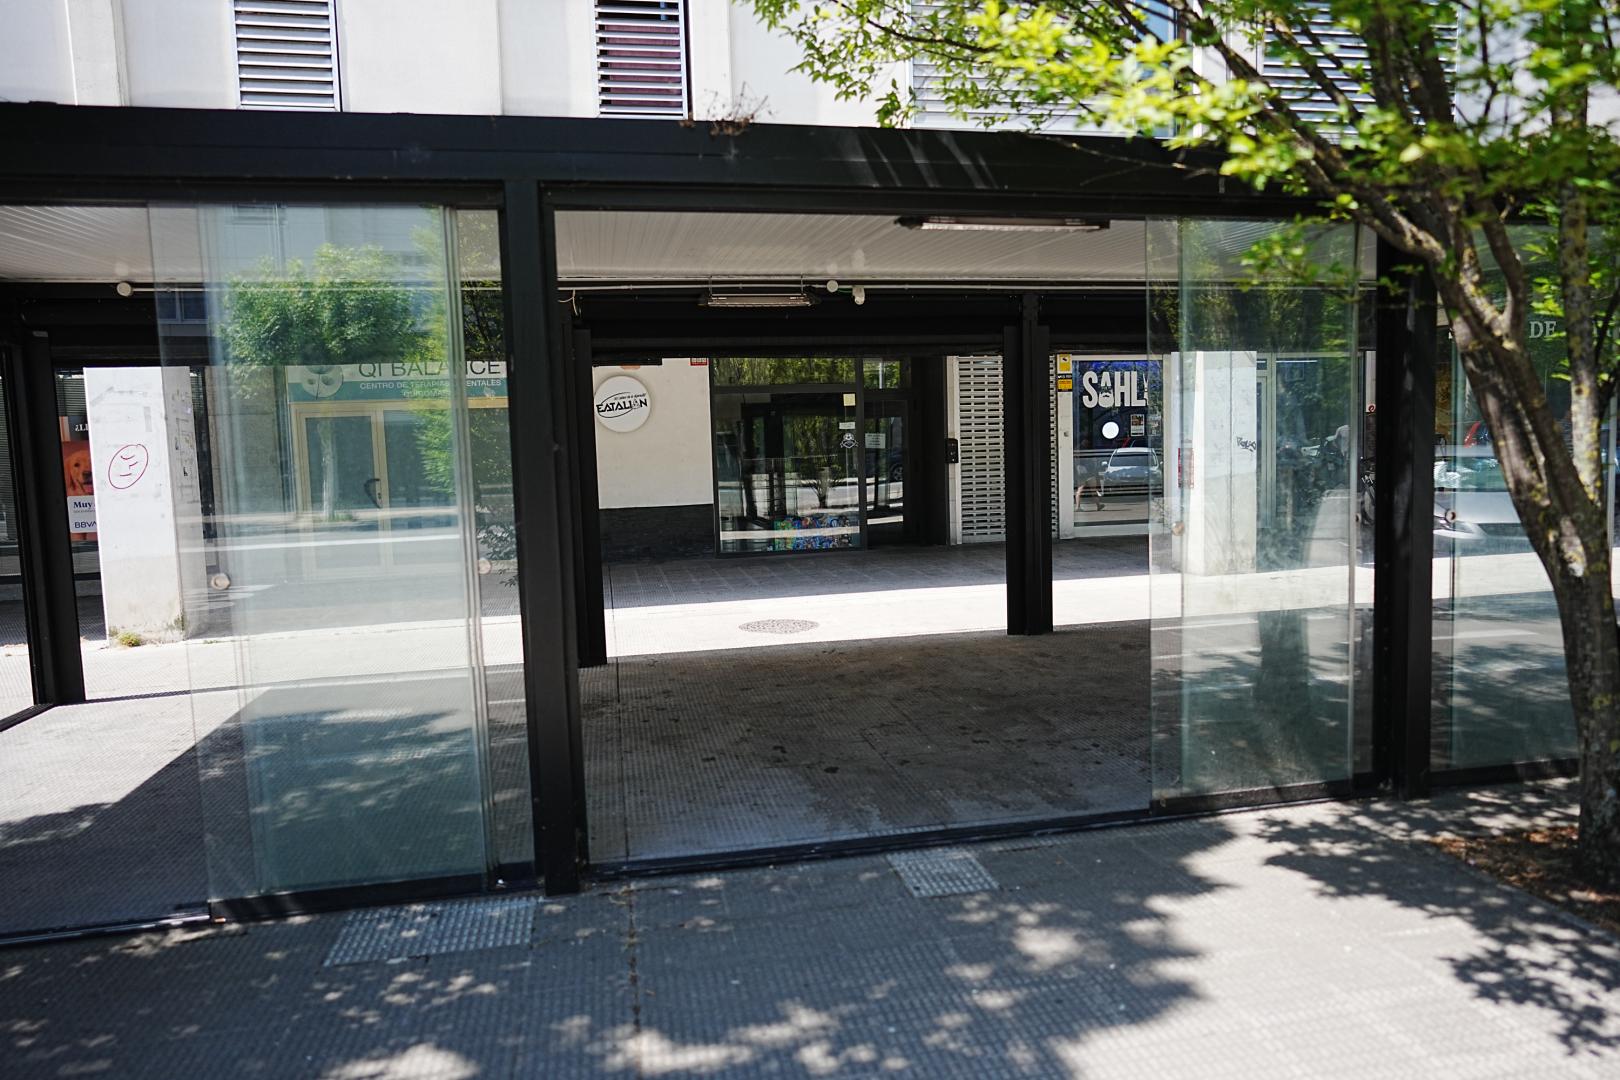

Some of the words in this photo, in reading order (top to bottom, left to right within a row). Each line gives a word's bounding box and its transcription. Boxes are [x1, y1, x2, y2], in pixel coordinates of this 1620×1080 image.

[391, 358, 500, 376] BALACE
[360, 382, 393, 390] CENTRO
[396, 381, 408, 389] DE
[463, 379, 501, 387] ENTALES
[73, 501, 92, 510] Muy
[74, 521, 97, 529] BBVA
